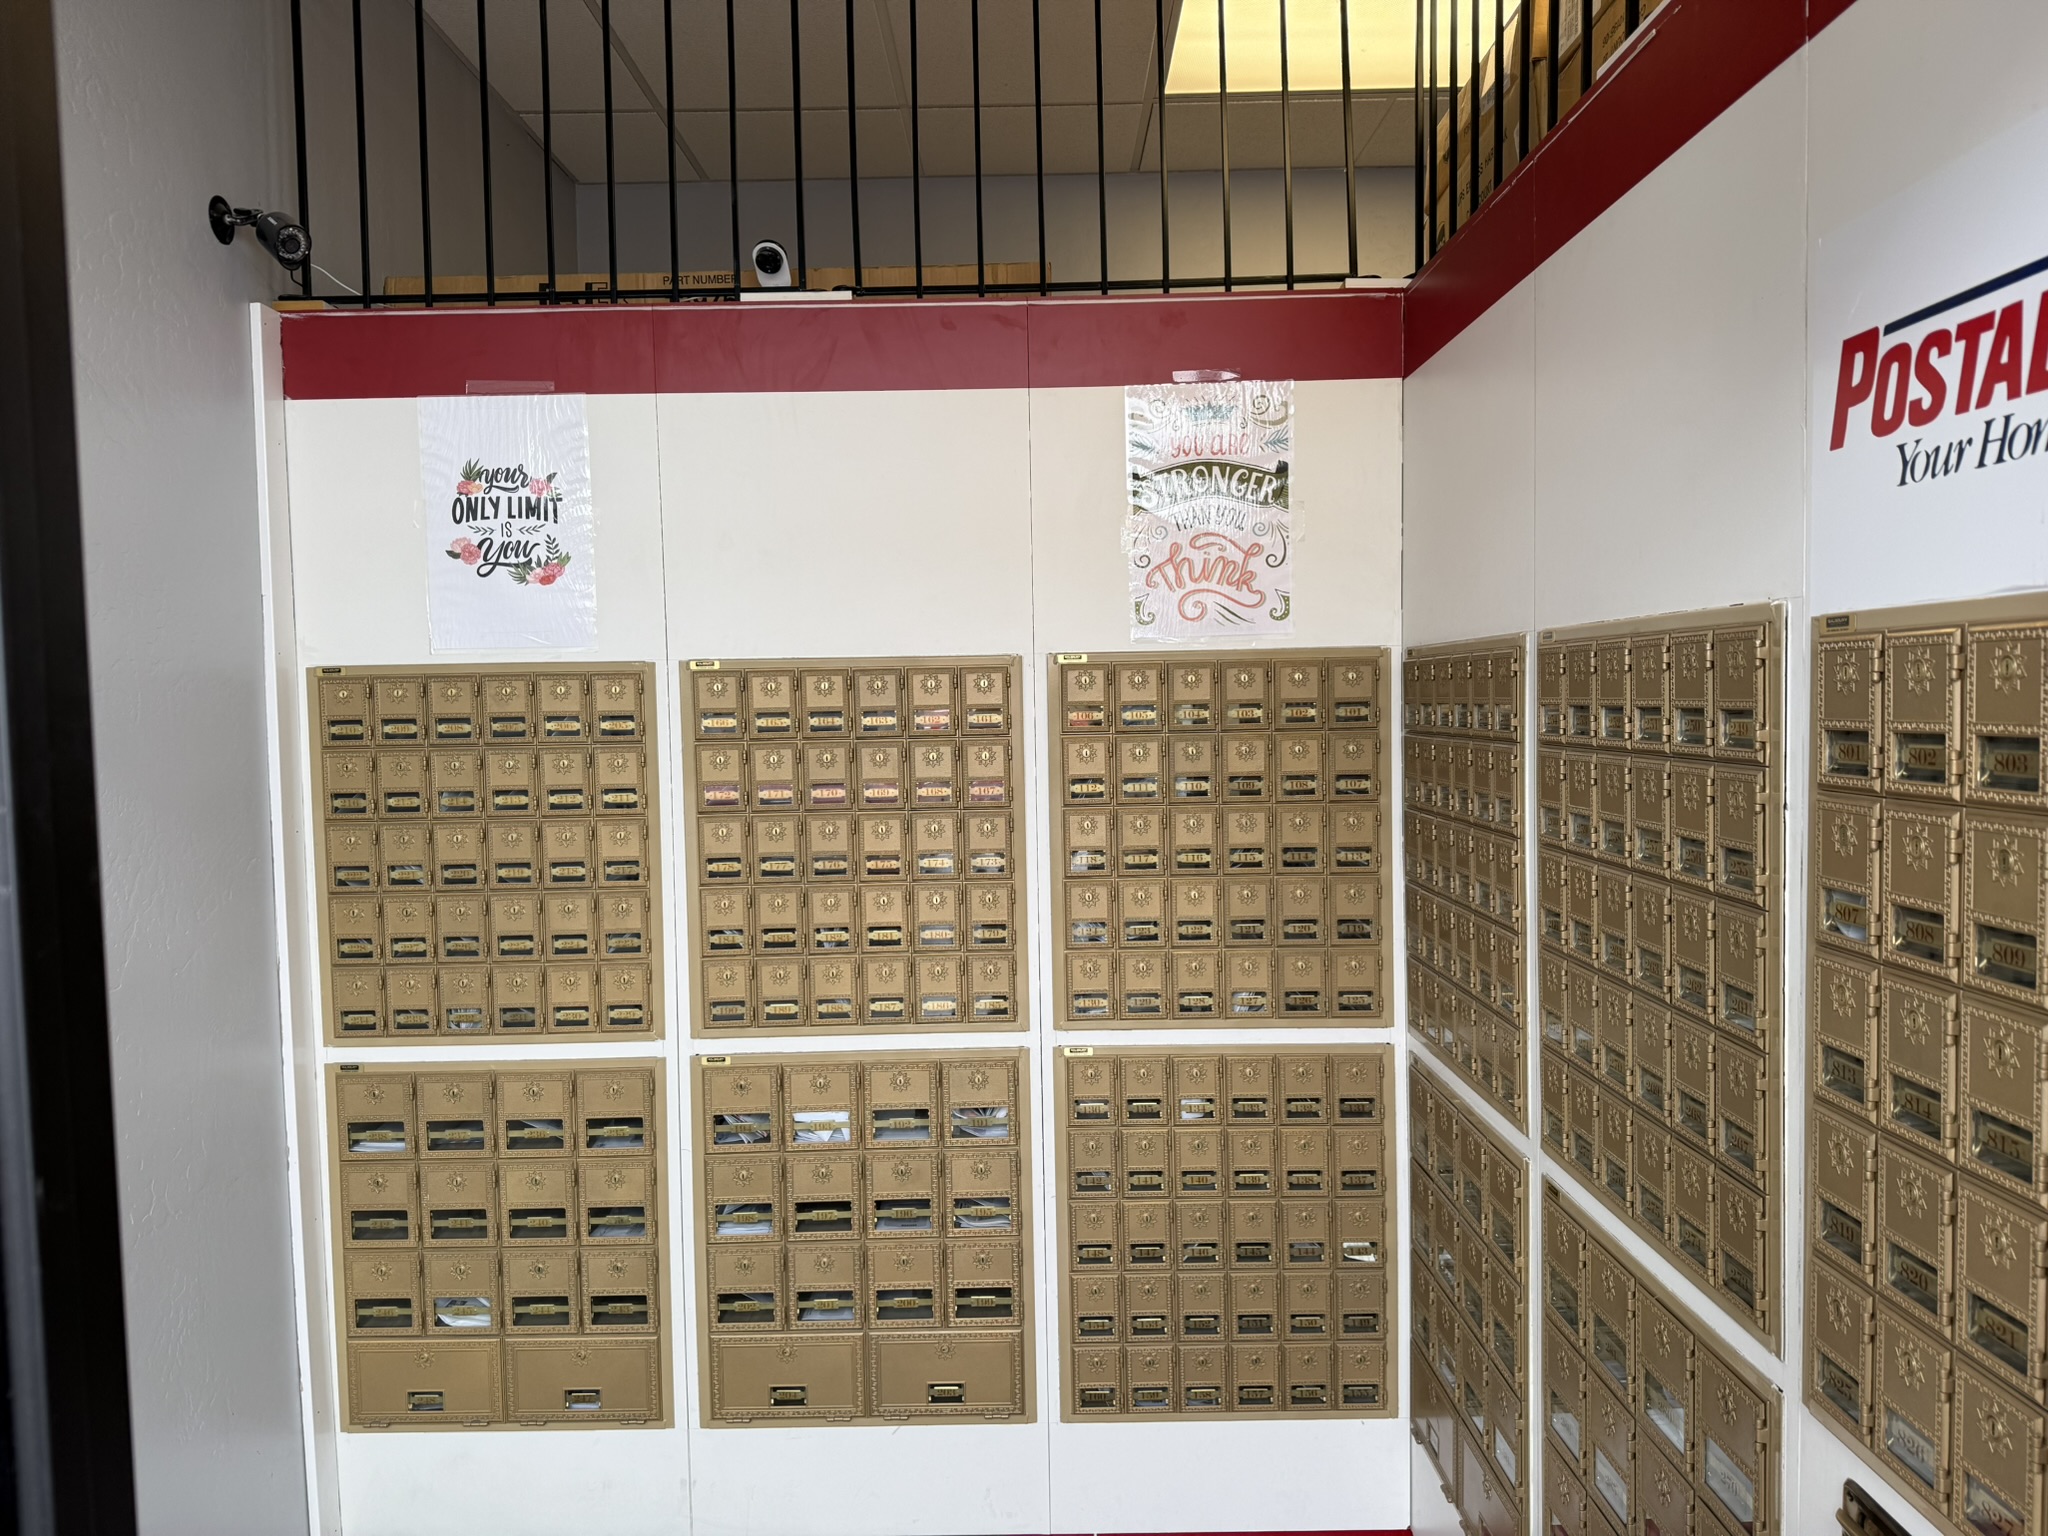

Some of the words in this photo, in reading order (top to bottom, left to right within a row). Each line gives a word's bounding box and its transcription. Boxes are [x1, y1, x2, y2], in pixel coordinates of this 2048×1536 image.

[1896, 436, 1972, 487] Your
[478, 464, 532, 494] your
[1141, 464, 1276, 508] STRONGER
[452, 496, 500, 525] ONLY
[508, 496, 563, 524] LIMIT
[1168, 508, 1213, 532] THAN
[500, 522, 512, 538] IS
[1146, 534, 1265, 622] Think
[1730, 722, 1748, 736] 249
[1839, 742, 1862, 762] 801
[1909, 746, 1936, 766] 802
[1994, 752, 2029, 774] 803
[1834, 904, 1860, 924] 807
[1906, 920, 1934, 944] 808
[1992, 942, 2026, 968] 809
[1832, 1062, 1856, 1084] 813
[1904, 1092, 1933, 1118] 814
[1987, 1130, 2020, 1159] 815
[1830, 1218, 1854, 1240] 819
[1899, 1260, 1928, 1291] 820
[1984, 1317, 2016, 1351] 821
[1827, 1370, 1852, 1401] 825
[1897, 1429, 1925, 1464] 826
